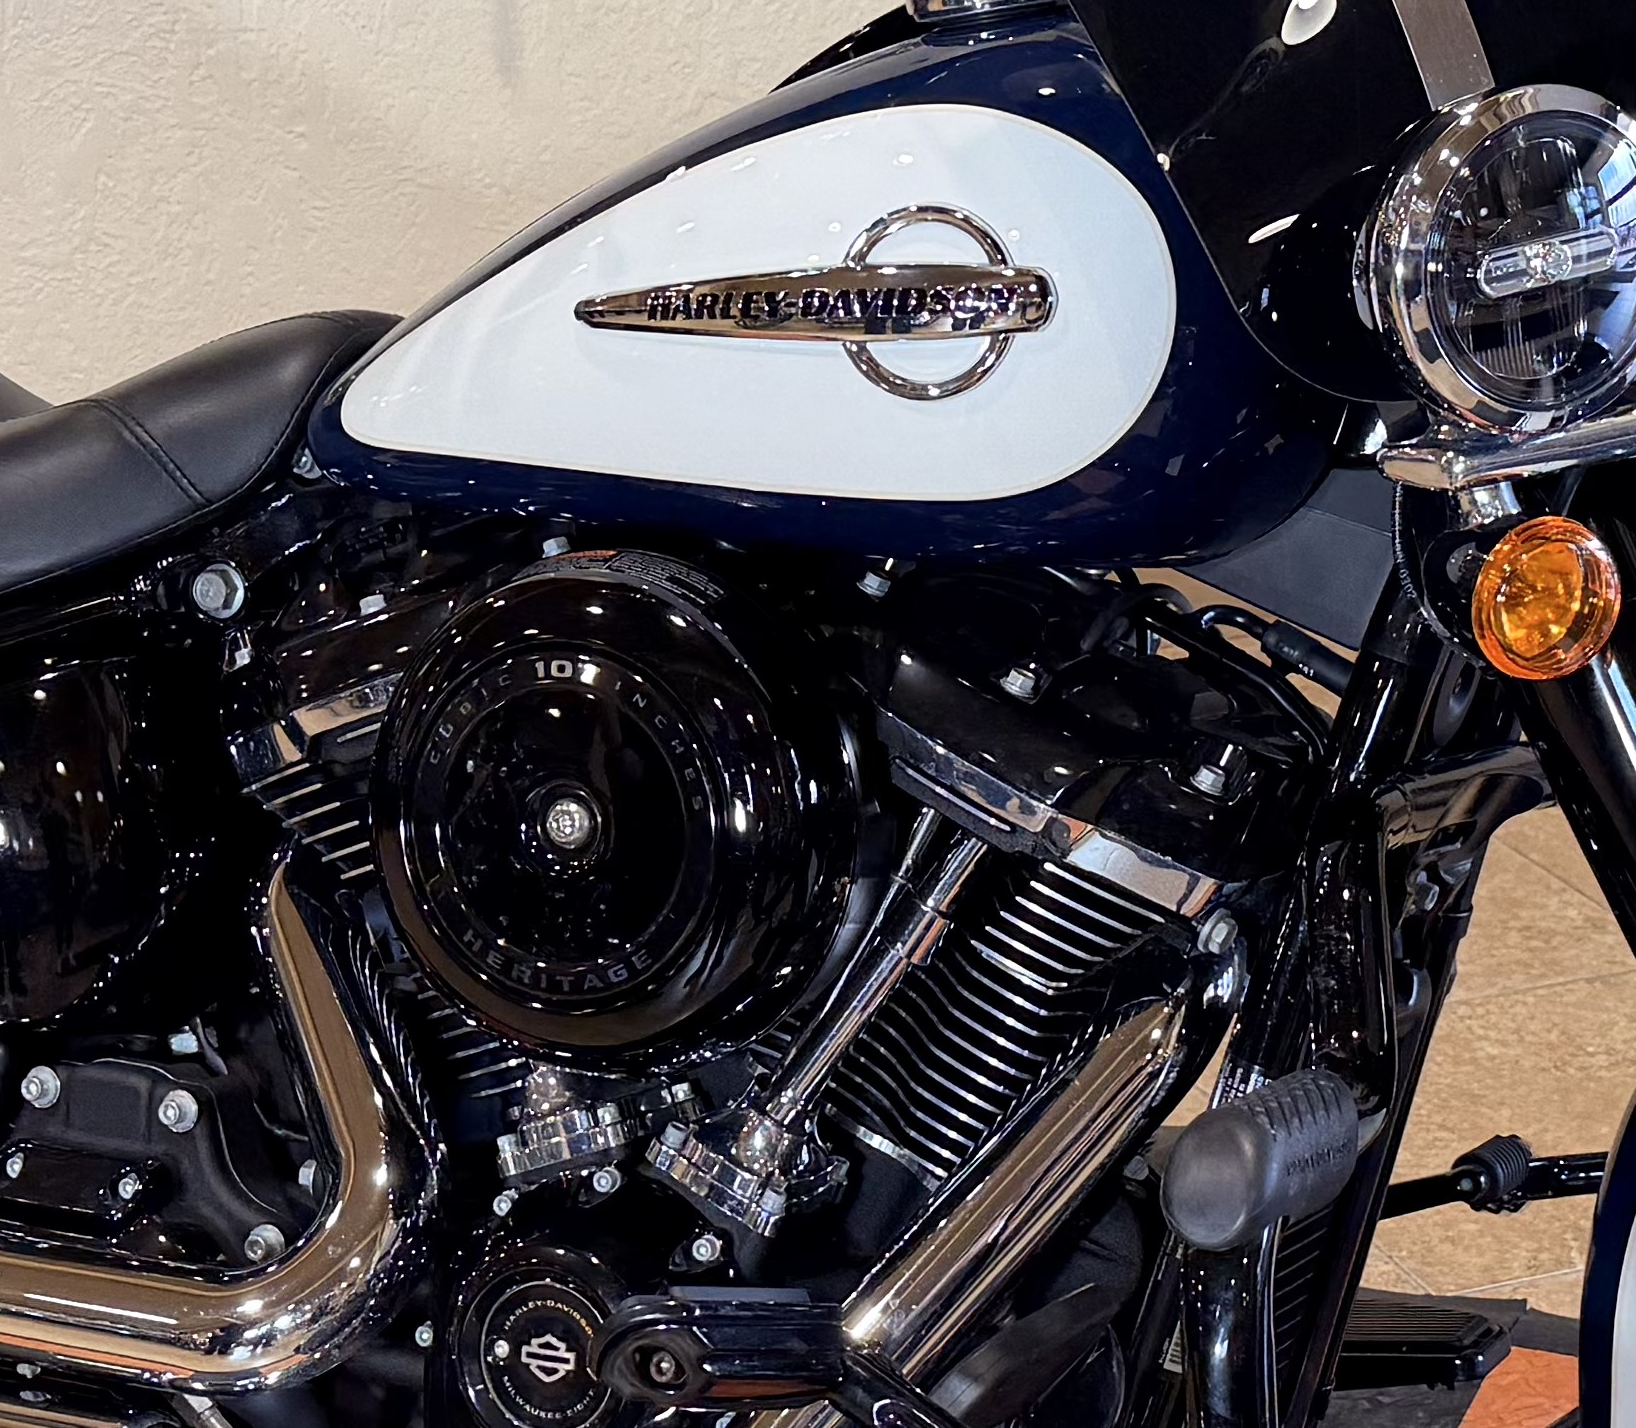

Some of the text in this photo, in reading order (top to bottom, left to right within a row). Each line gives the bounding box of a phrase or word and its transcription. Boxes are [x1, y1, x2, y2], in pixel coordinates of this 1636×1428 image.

[535, 659, 601, 686] 107
[613, 680, 704, 811] INCHES
[463, 928, 653, 993] HERITAGE
[503, 1299, 595, 1338] HARLEY-DAVIDSO
